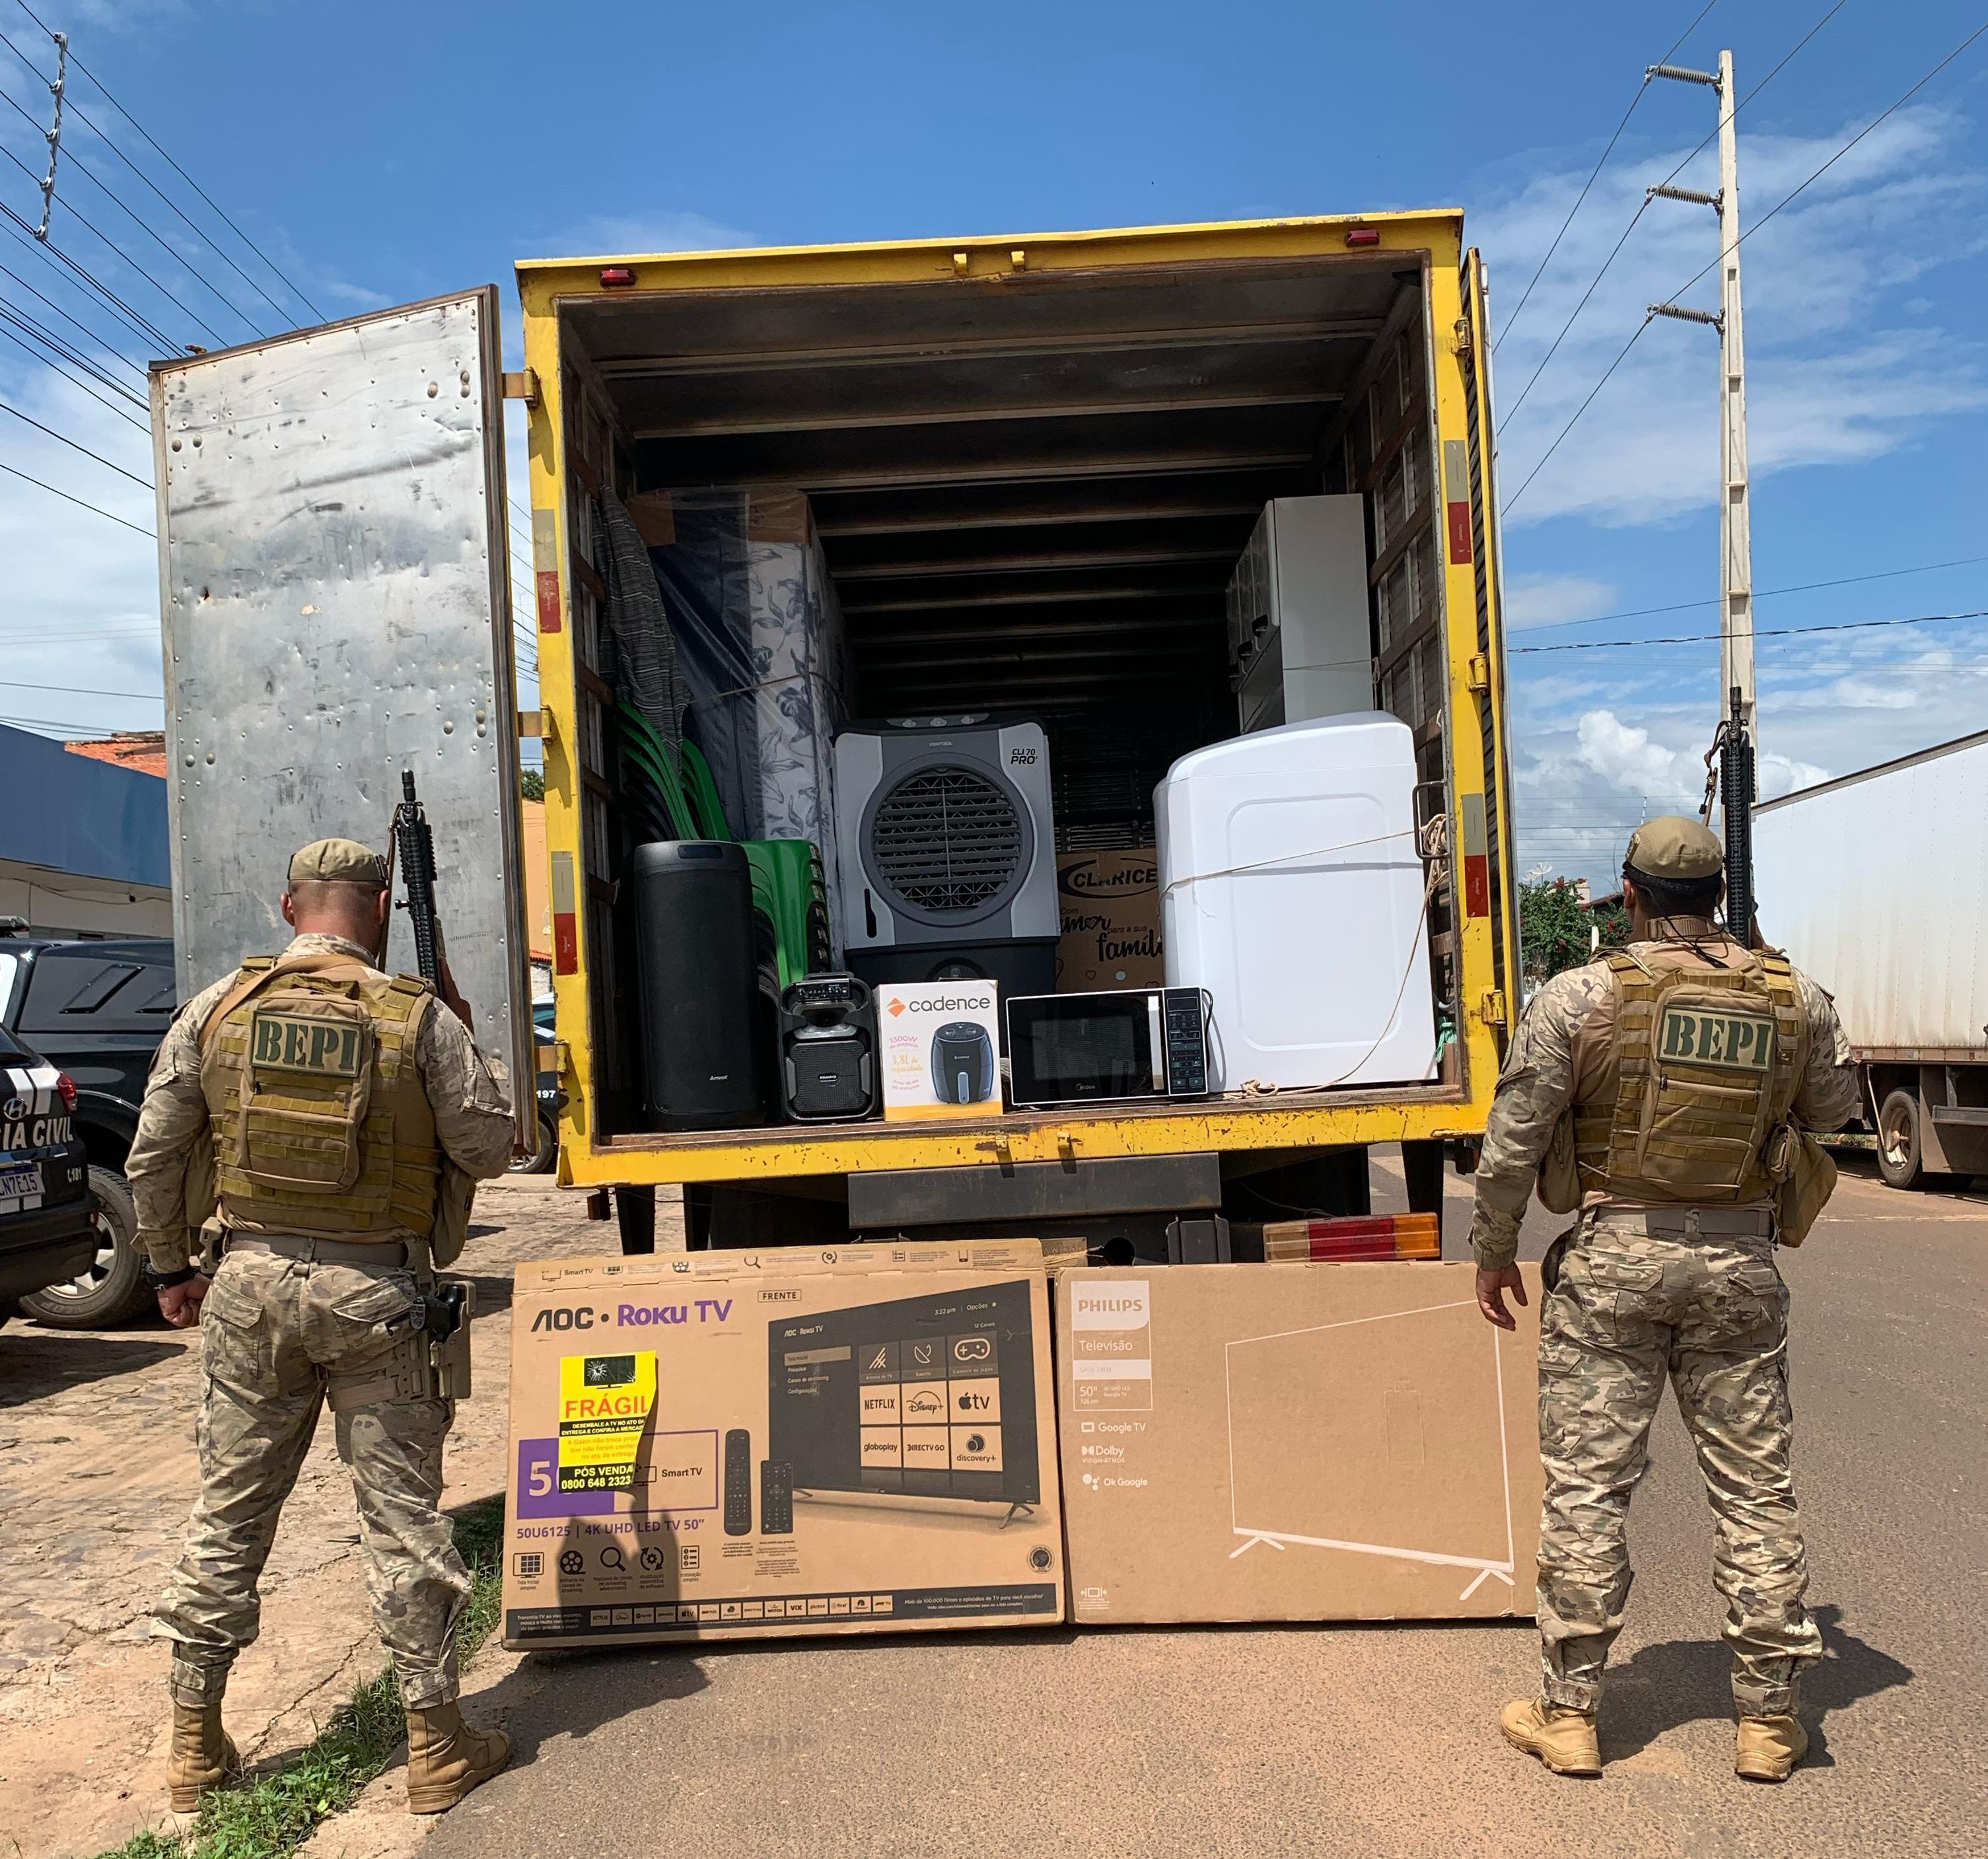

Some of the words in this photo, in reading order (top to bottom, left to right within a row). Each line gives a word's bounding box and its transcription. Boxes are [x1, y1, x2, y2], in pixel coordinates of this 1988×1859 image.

[1107, 927, 1124, 935] para
[909, 995, 991, 1012] cadence
[255, 1020, 357, 1071] BEPI
[1663, 1014, 1771, 1066] BEPI
[893, 1055, 909, 1065] 3,8L
[536, 1090, 556, 1099] 197
[0, 1122, 27, 1150] IA
[33, 1116, 74, 1147] CIVIL
[0, 1174, 38, 1195] N7E15
[763, 1292, 797, 1300] FRENTE
[1079, 1299, 1143, 1312] PHILIPS
[530, 1307, 594, 1332] AOC
[618, 1304, 687, 1327] Roku
[695, 1300, 732, 1321] TV
[1079, 1340, 1133, 1351] Televisão
[565, 1393, 648, 1419] FRÁGIL
[865, 1398, 895, 1410] NETFLIX
[973, 1394, 990, 1409] tv
[1098, 1422, 1131, 1434] Google
[1133, 1422, 1146, 1432] TV
[864, 1442, 898, 1452] globoplay
[1096, 1446, 1124, 1457] Dolby
[956, 1454, 996, 1463] discovery+
[575, 1466, 596, 1477] PÓS
[598, 1465, 633, 1476] VENDA
[662, 1469, 689, 1477] Smart
[690, 1467, 702, 1476] TV
[561, 1479, 585, 1490] 0800
[588, 1478, 605, 1488] 648
[608, 1475, 631, 1487] 2323
[1118, 1478, 1148, 1487] Google
[516, 1526, 571, 1539] 50U6125
[585, 1524, 600, 1535] 4K
[605, 1522, 633, 1534] UHD
[638, 1521, 660, 1532] LED
[664, 1520, 680, 1531] TV
